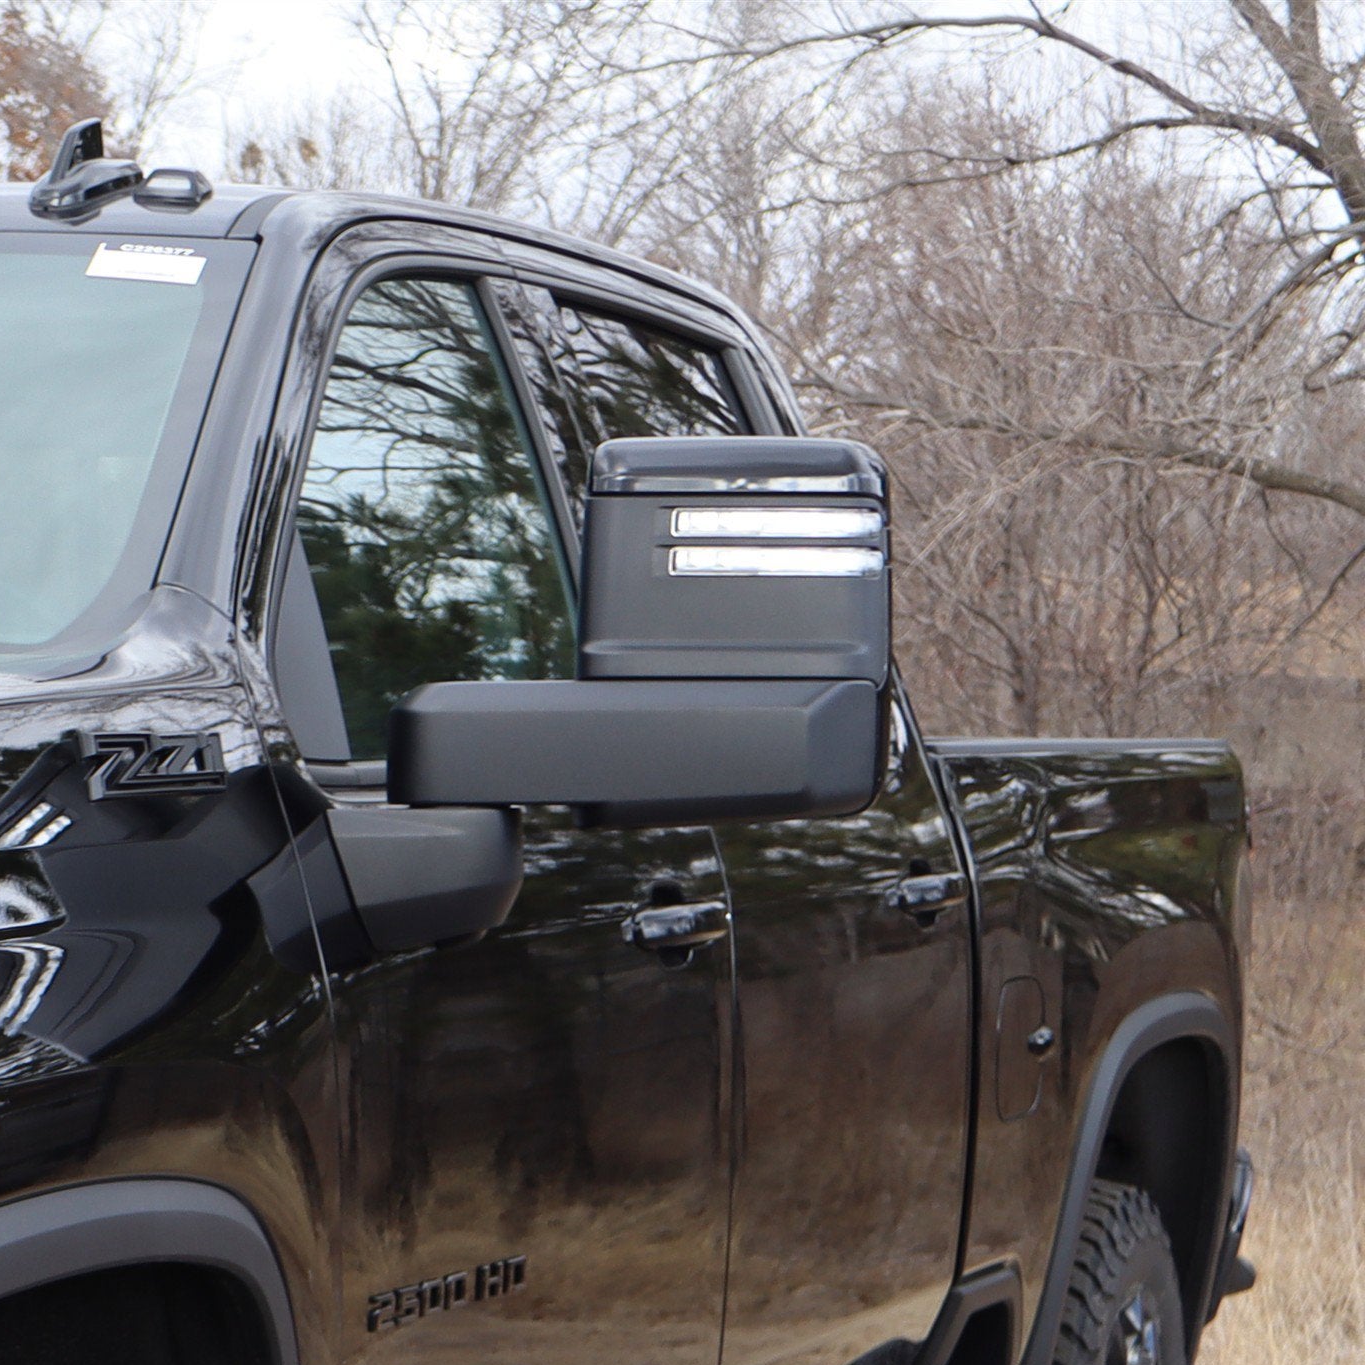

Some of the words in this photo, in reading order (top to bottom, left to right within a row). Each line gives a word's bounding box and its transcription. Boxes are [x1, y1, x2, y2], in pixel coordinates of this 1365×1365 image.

[76, 730, 228, 801] Z71
[366, 1271, 468, 1332] 2500
[473, 1255, 528, 1302] HD
